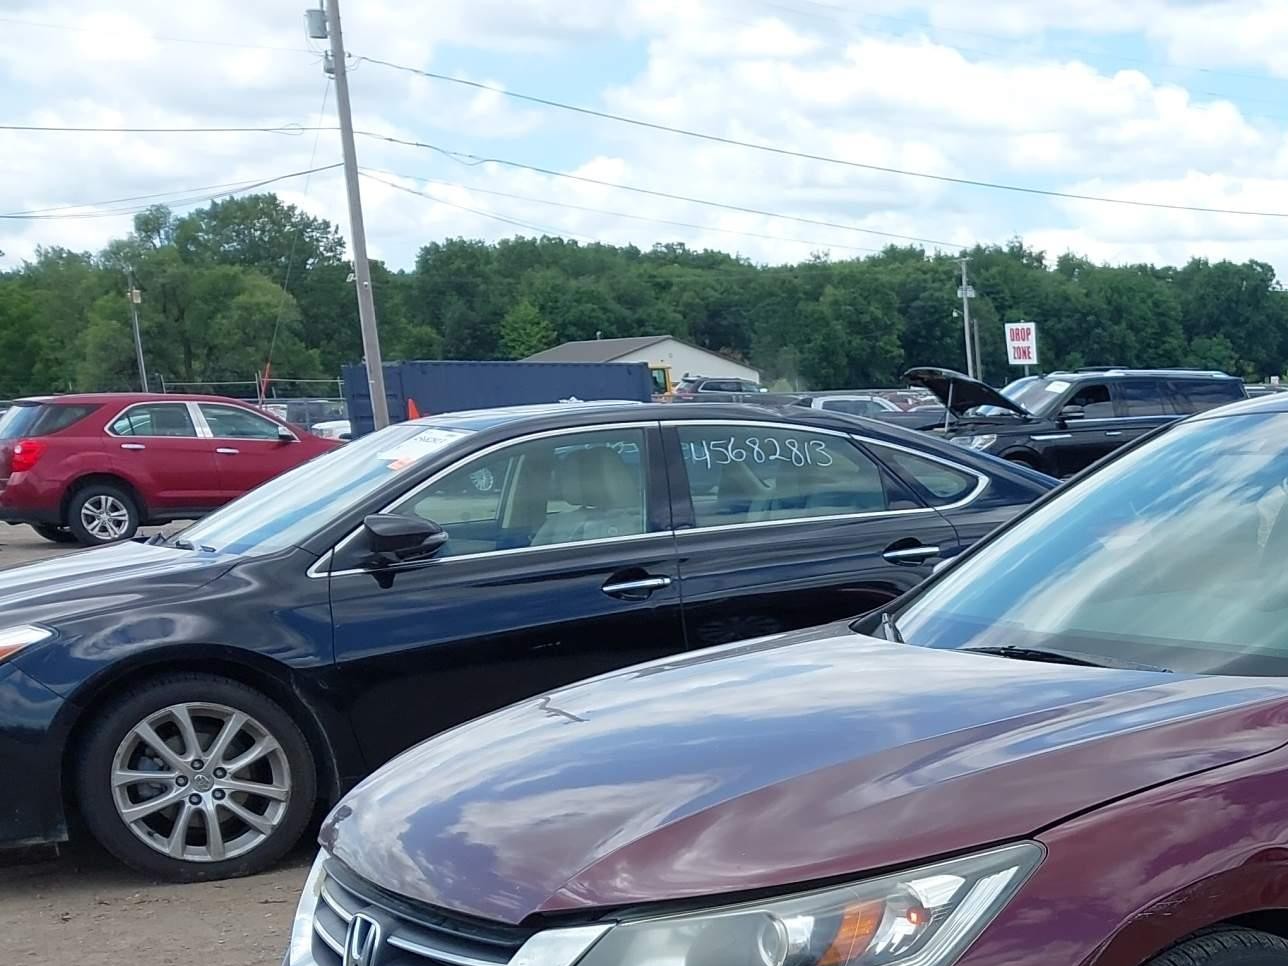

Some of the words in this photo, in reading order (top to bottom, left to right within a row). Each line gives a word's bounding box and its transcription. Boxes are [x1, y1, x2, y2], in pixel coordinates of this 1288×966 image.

[1010, 328, 1031, 341] DROP
[1013, 346, 1032, 359] ZONE
[690, 437, 833, 469] 45682813
